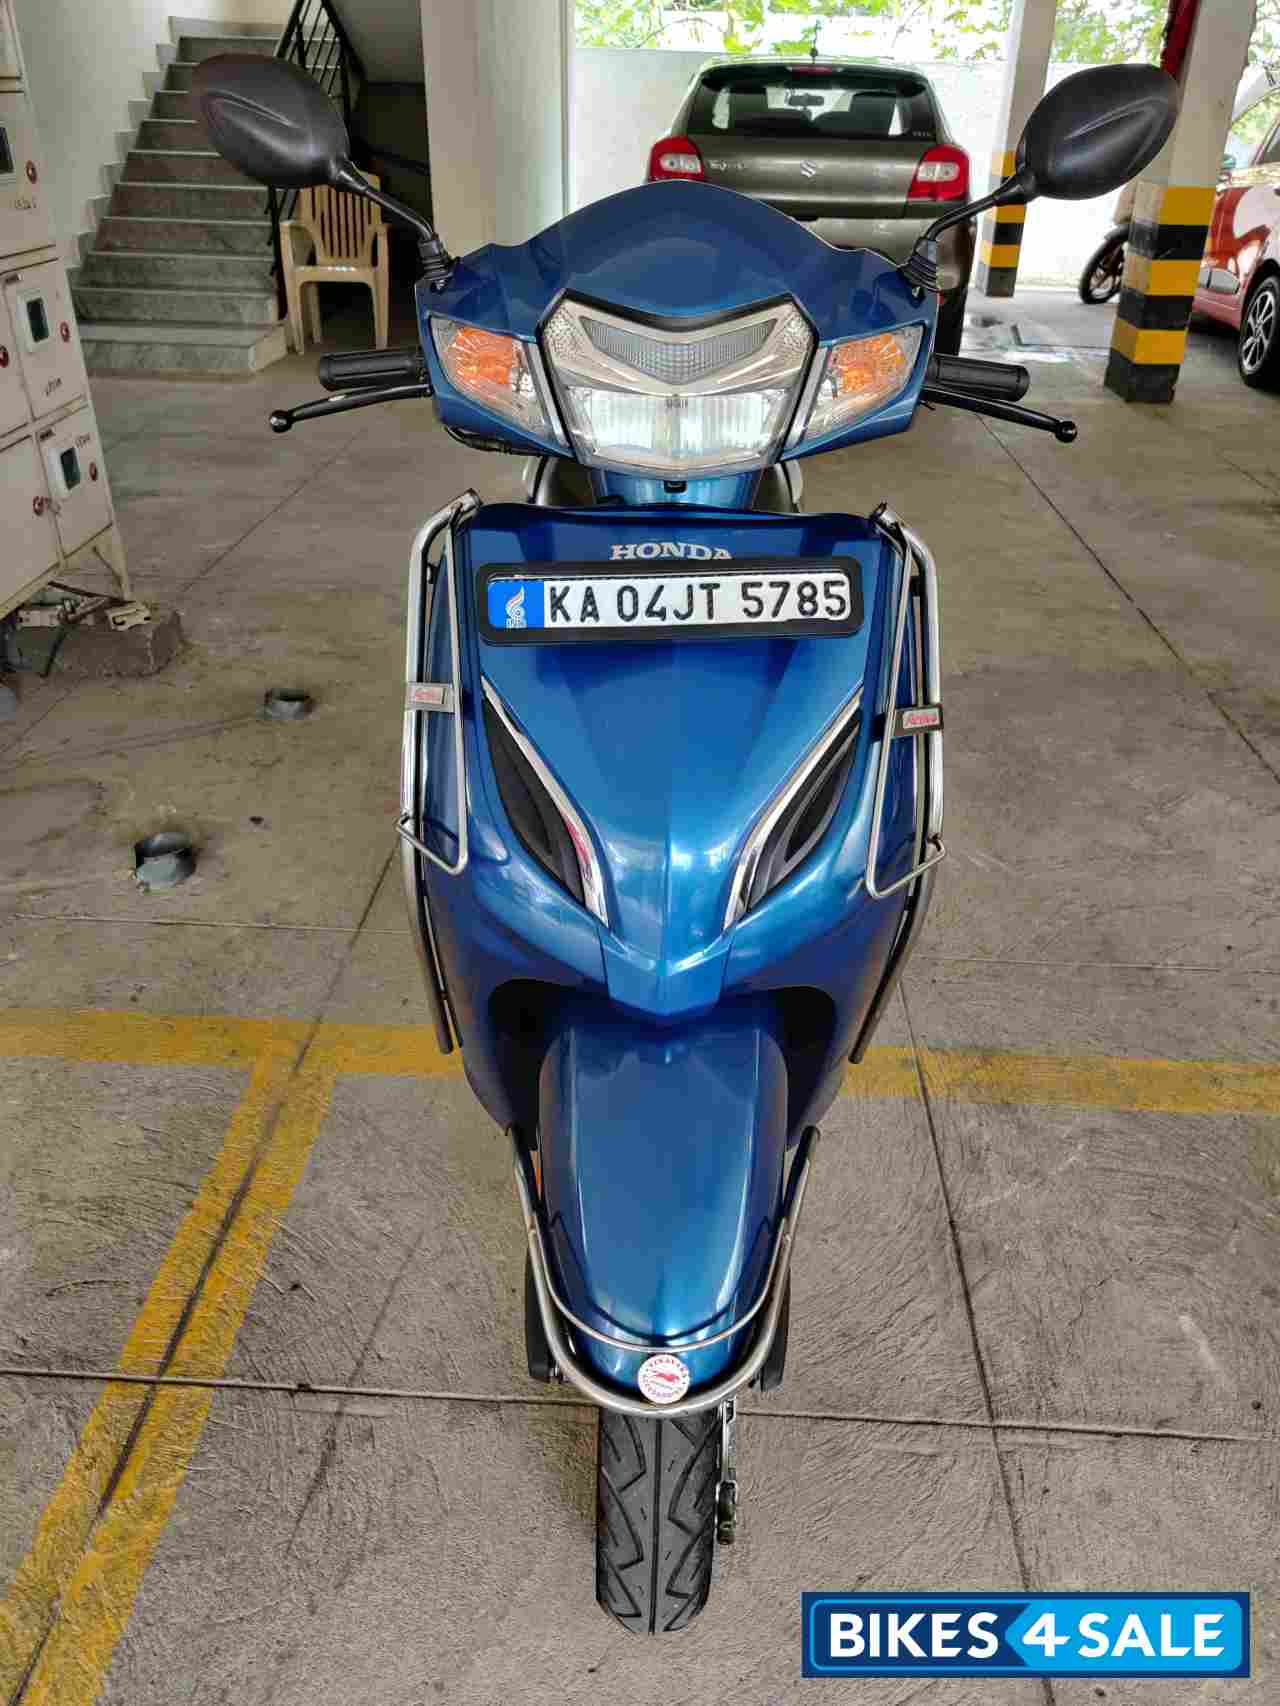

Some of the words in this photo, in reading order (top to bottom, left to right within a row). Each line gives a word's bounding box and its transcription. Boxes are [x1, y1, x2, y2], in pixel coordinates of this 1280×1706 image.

[610, 542, 733, 560] HONDA
[549, 585, 600, 623] KA
[617, 582, 721, 622] 04JT
[741, 580, 846, 619] 5785
